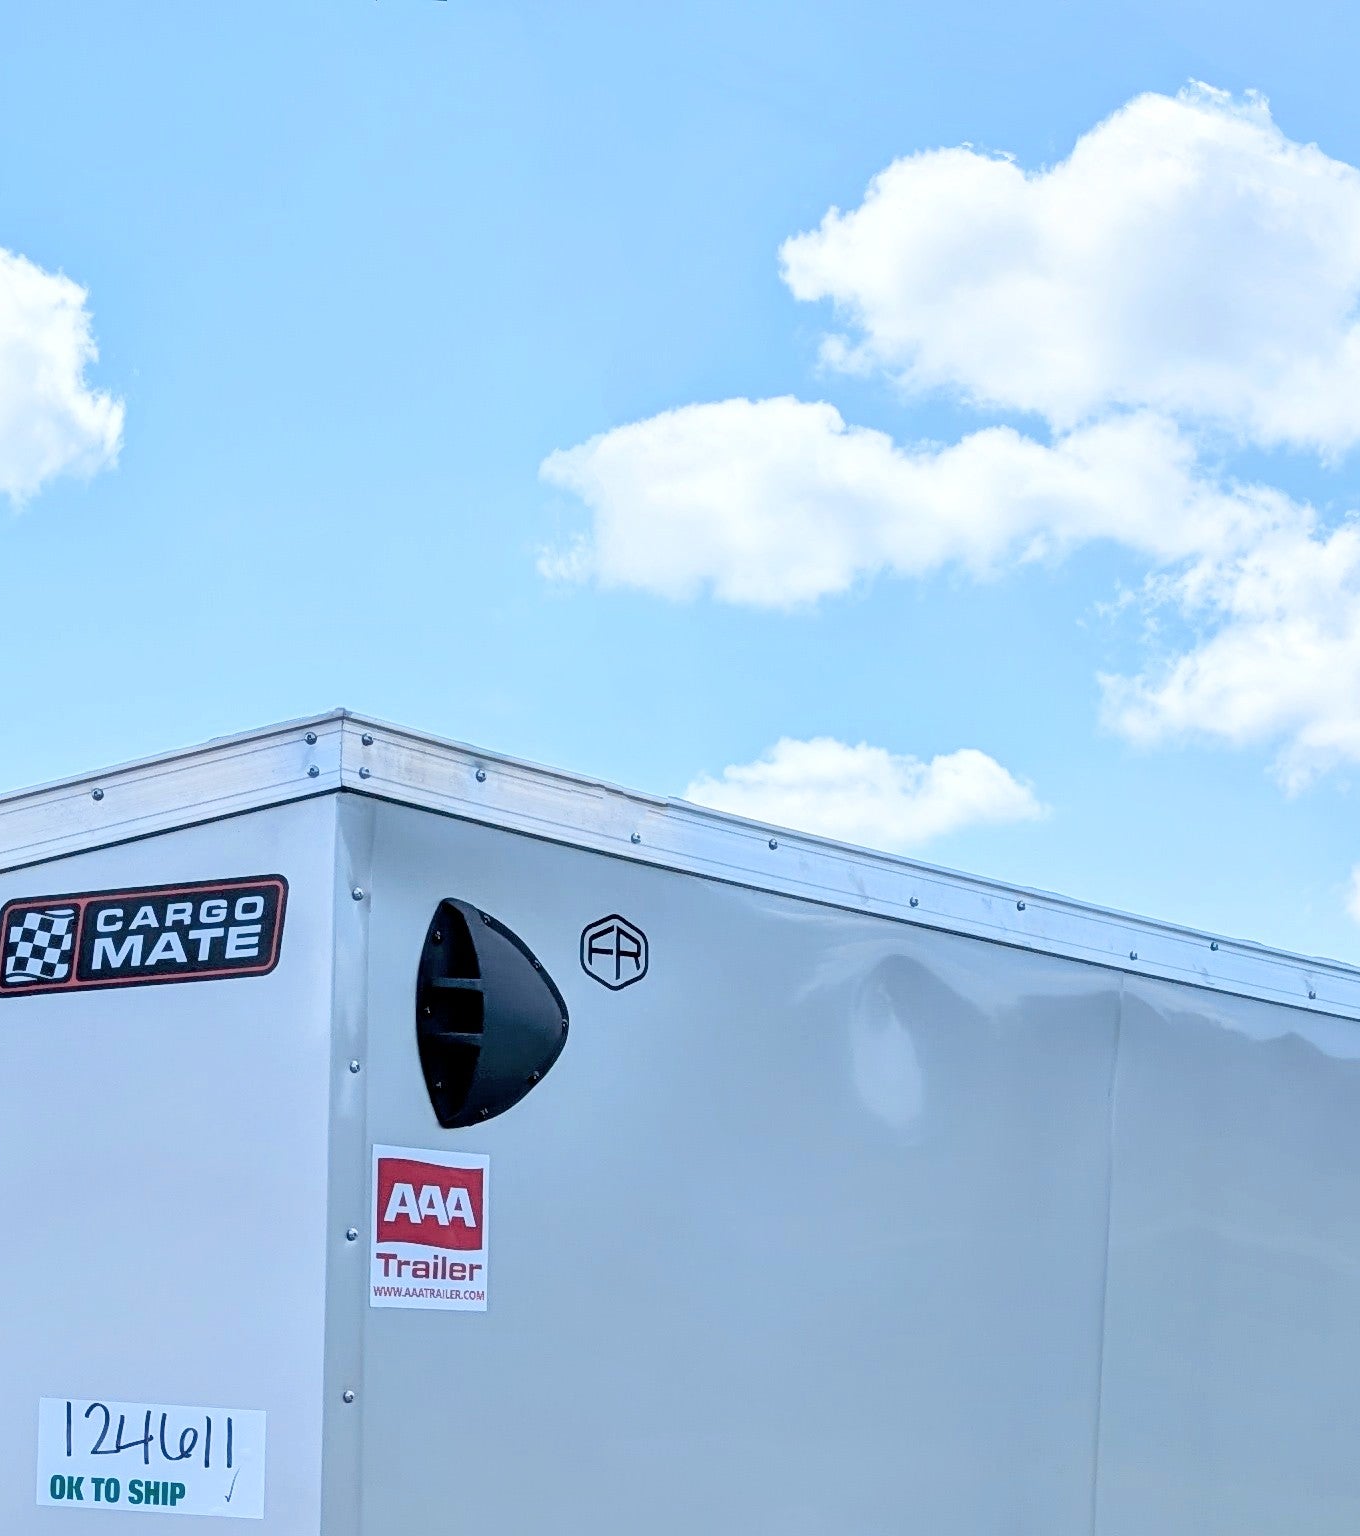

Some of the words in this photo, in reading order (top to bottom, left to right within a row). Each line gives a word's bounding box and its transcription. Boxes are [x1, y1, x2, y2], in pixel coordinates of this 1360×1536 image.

[96, 895, 265, 933] CARGO
[91, 924, 262, 971] MATE
[383, 1182, 477, 1228] AAA
[375, 1252, 483, 1281] Trailer
[372, 1285, 486, 1301] WWW.AAATRAILER.COM
[66, 1401, 233, 1469] 124611
[49, 1474, 85, 1501] OK
[90, 1477, 121, 1504] TO
[127, 1478, 187, 1507] SHIP
